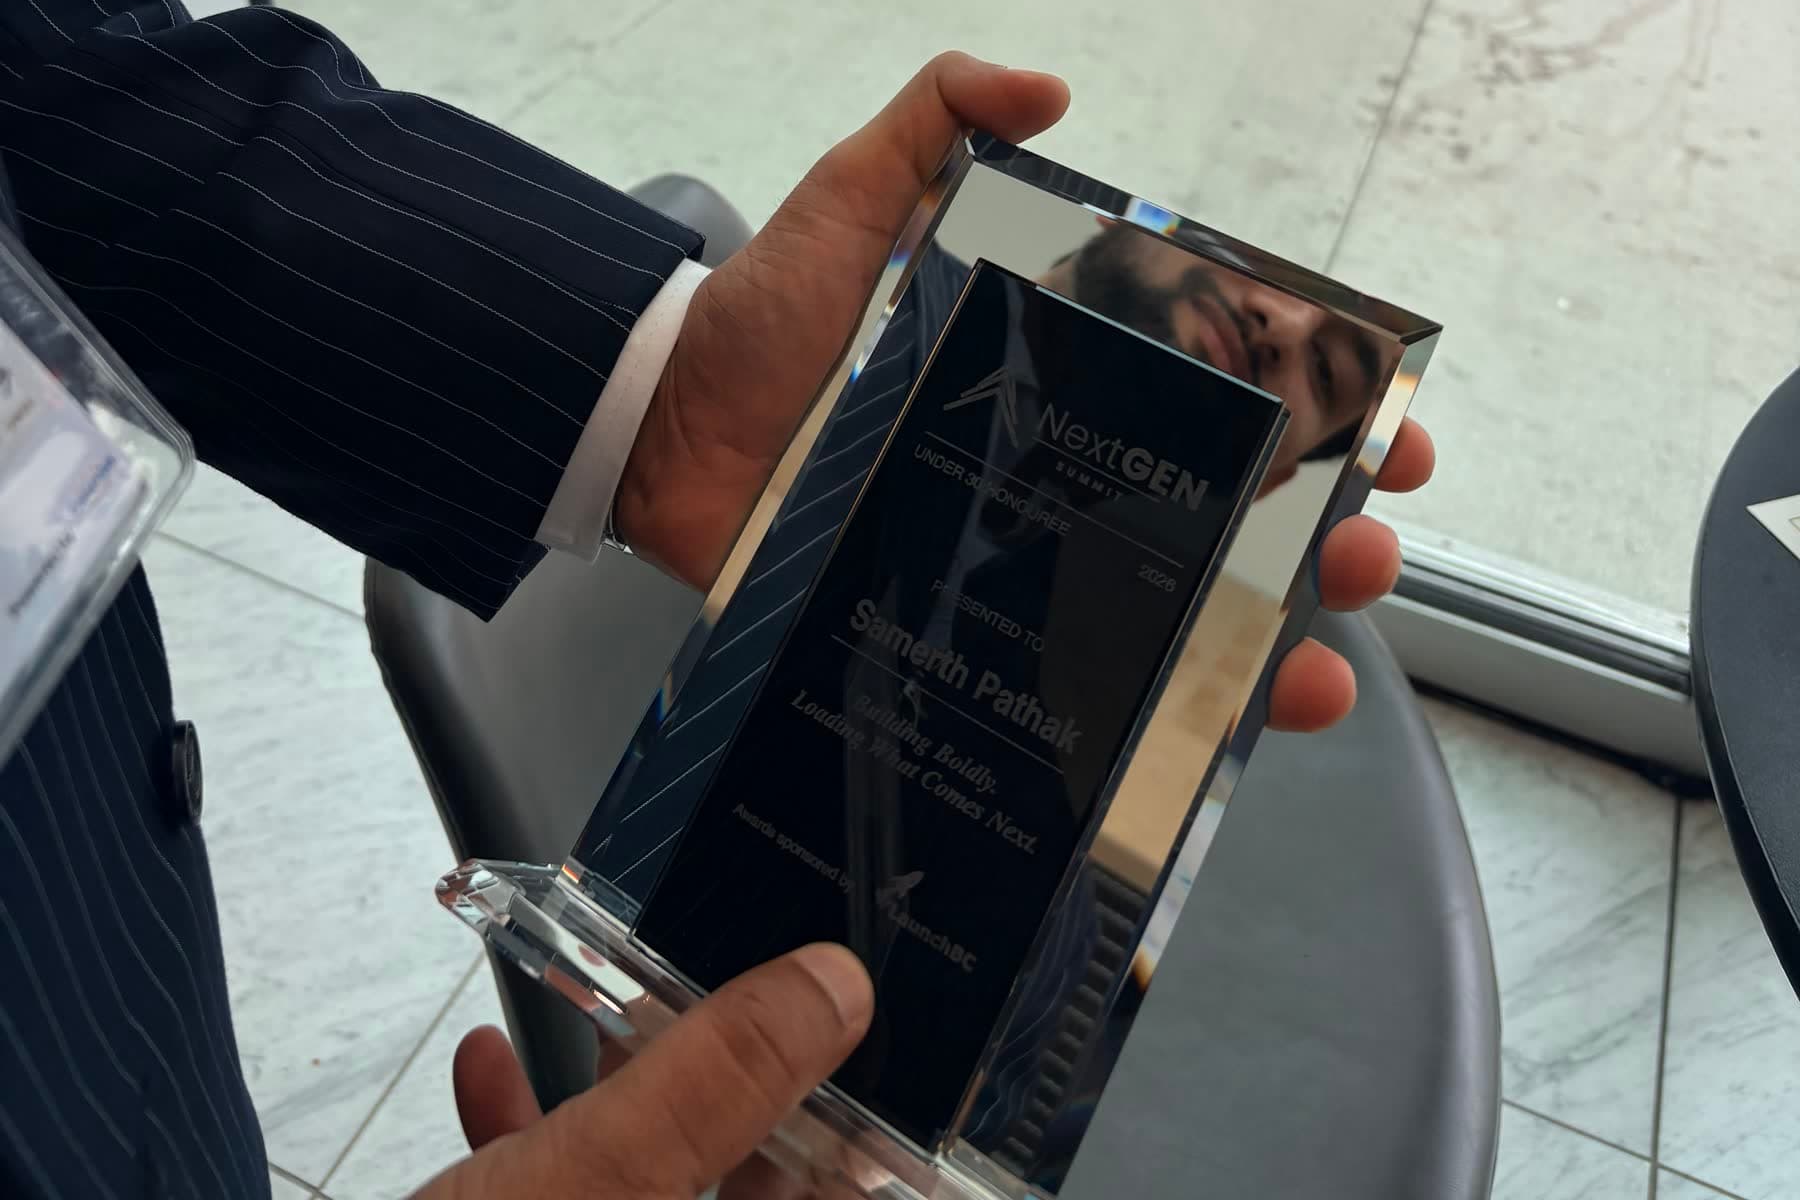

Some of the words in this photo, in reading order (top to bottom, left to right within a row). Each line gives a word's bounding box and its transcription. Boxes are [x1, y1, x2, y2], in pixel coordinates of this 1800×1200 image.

[913, 443, 964, 482] UNDER
[1039, 402, 1210, 512] NextGEN
[1055, 460, 1124, 502] SUMMIT
[929, 578, 1022, 639] PESENTED
[1023, 630, 1046, 654] TO
[855, 695, 934, 757] Building
[932, 743, 999, 796] Boldly.
[972, 669, 1084, 756] Pathak
[920, 770, 984, 821] Comes
[984, 811, 1039, 856] Next.
